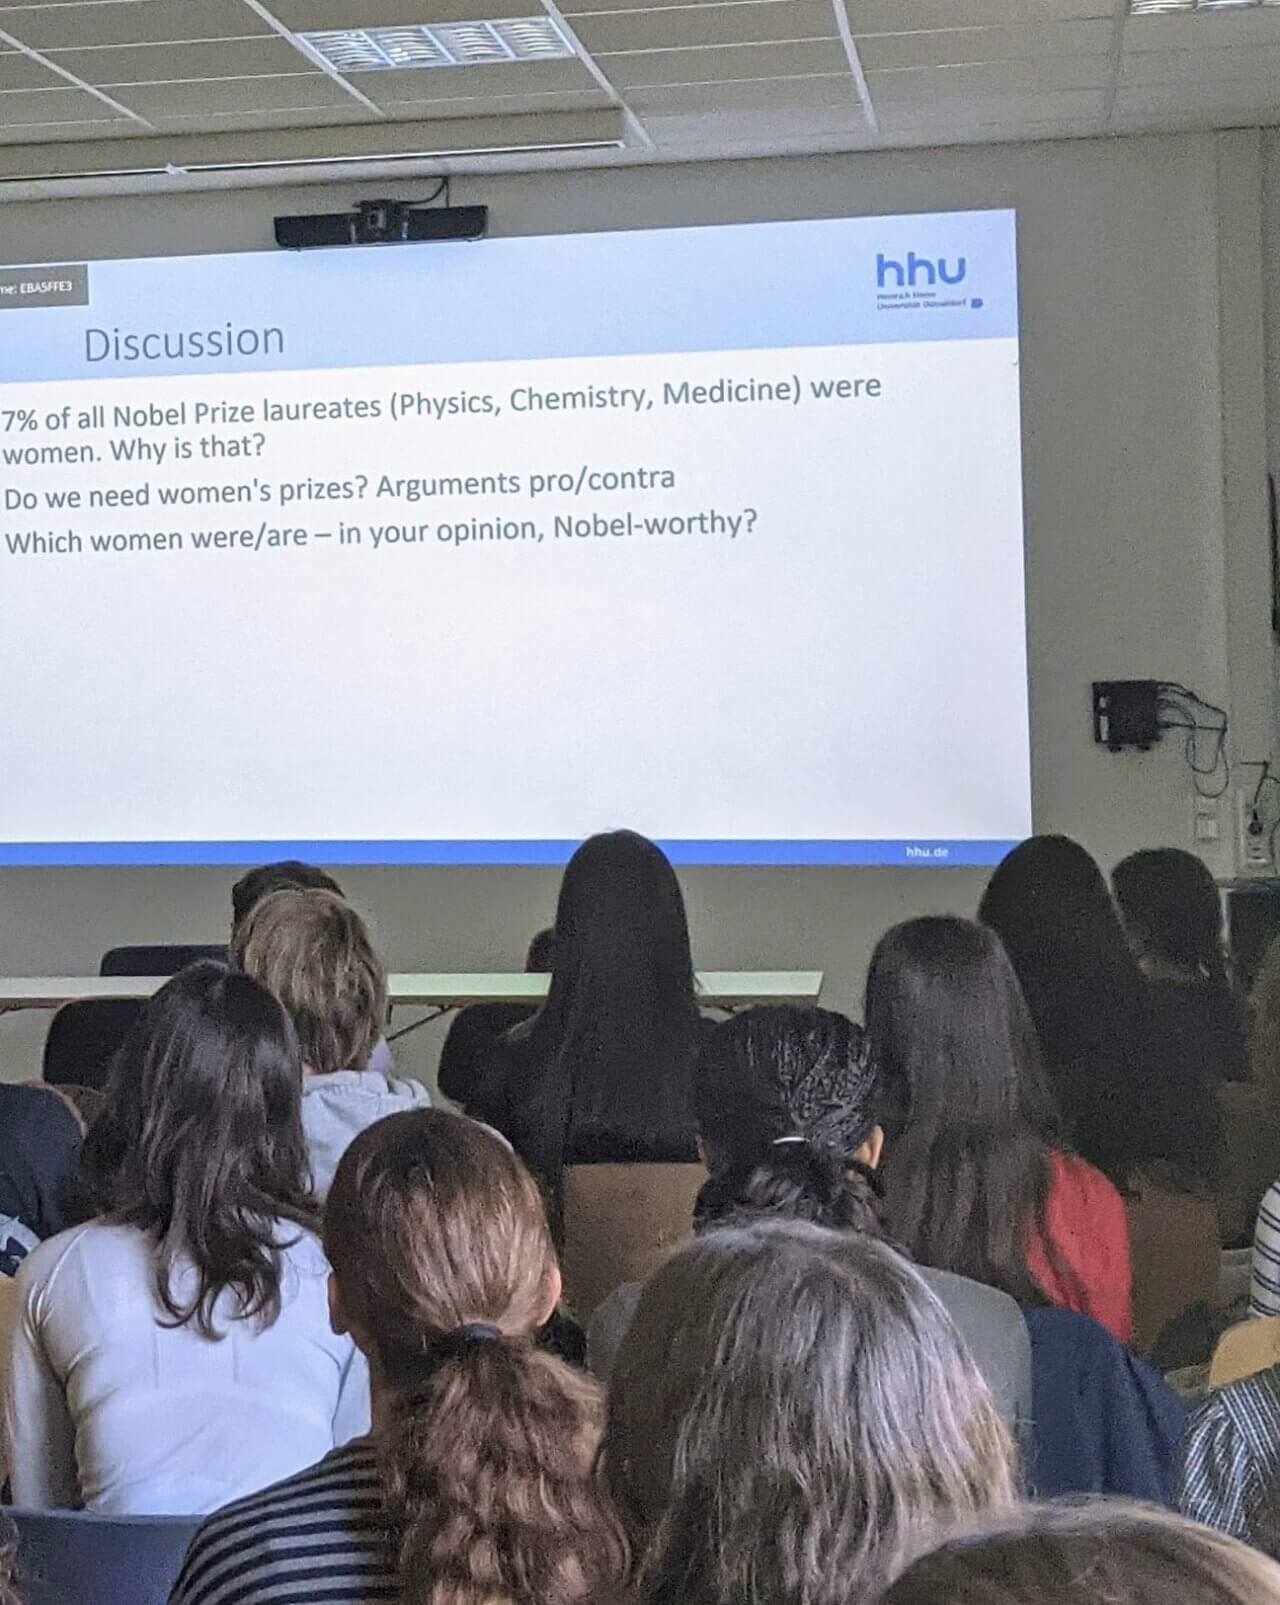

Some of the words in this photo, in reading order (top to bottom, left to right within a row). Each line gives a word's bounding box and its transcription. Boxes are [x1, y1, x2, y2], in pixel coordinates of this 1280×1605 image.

[876, 251, 966, 288] hhu
[85, 321, 284, 362] Discussion
[1, 409, 39, 433] 7%
[45, 405, 72, 431] of
[77, 404, 105, 430] all
[113, 401, 186, 428] Nobel
[194, 399, 255, 425] Prize
[263, 396, 382, 423] laureates
[390, 389, 502, 422] (Physics,
[509, 384, 654, 413] Chemistry,
[663, 374, 801, 406] Medicine)
[809, 378, 882, 399] were
[1, 444, 102, 466] women.
[109, 436, 167, 466] Why
[174, 436, 193, 460] is
[199, 431, 266, 459] that?
[4, 488, 38, 511] Do
[44, 490, 82, 509] we
[89, 481, 150, 508] need
[157, 477, 272, 505] women's
[279, 474, 369, 507] prizes?
[375, 472, 521, 503] Arguments
[529, 464, 676, 499] pro/contra
[4, 528, 83, 555] Which
[89, 531, 183, 553] women
[190, 521, 308, 552] were/are
[338, 521, 362, 545] in
[368, 523, 430, 550] your
[436, 516, 545, 547] opinion,
[553, 507, 758, 539] Nobel-worthy?
[906, 847, 949, 858] hhu.de
